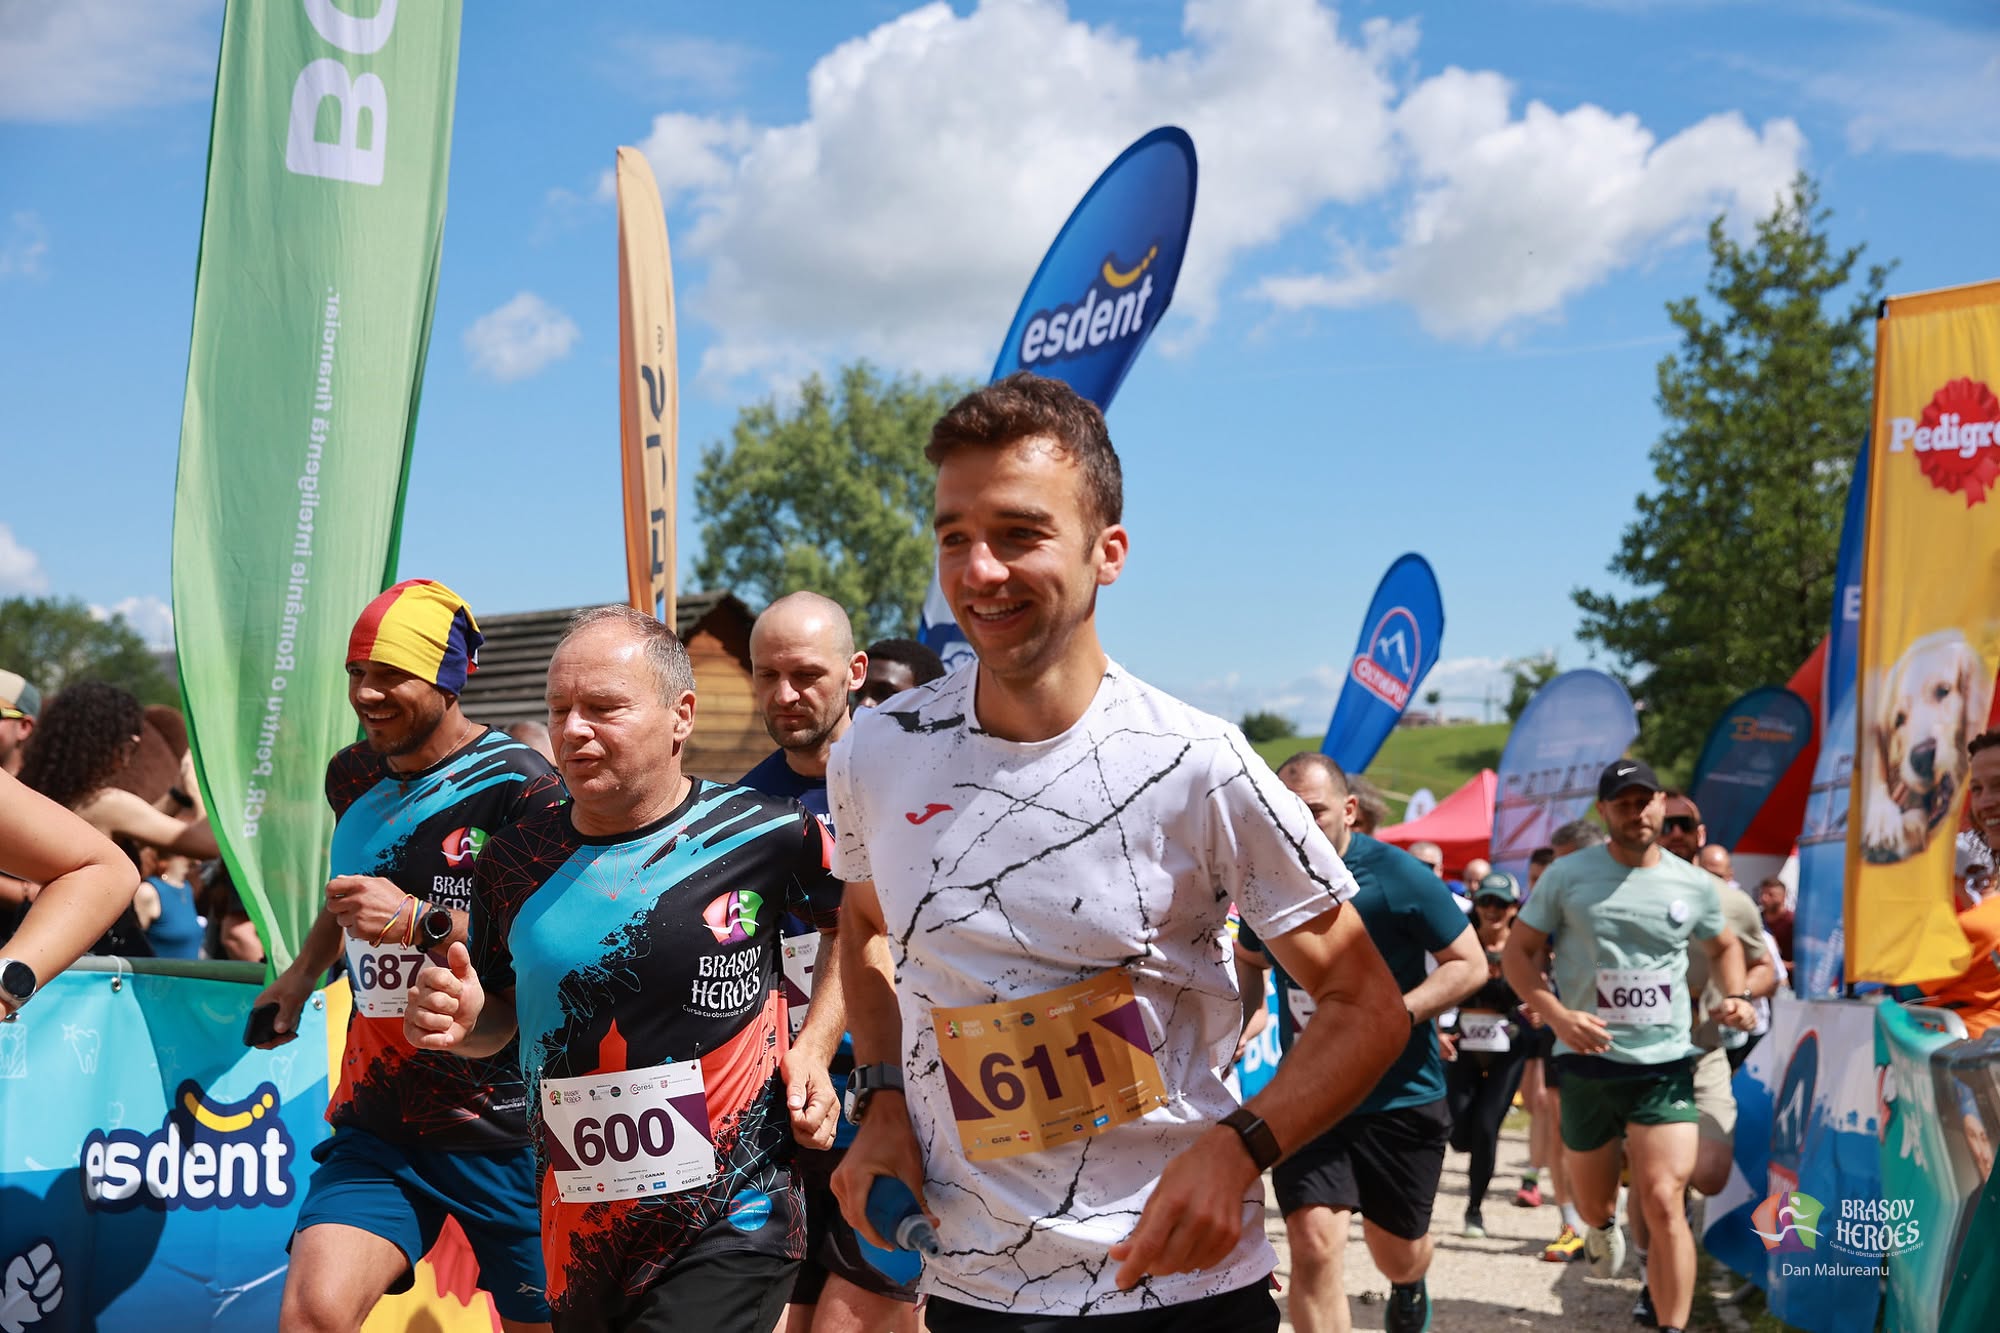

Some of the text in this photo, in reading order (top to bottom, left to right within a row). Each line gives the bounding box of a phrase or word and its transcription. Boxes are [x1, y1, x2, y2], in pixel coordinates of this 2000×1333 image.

[1021, 274, 1153, 363] esdent
[359, 953, 426, 990] 687
[691, 966, 761, 1011] HEROES
[1613, 987, 1657, 1008] 603
[979, 1031, 1106, 1112] 611
[86, 1122, 288, 1201] esdent
[573, 1107, 675, 1167] 600
